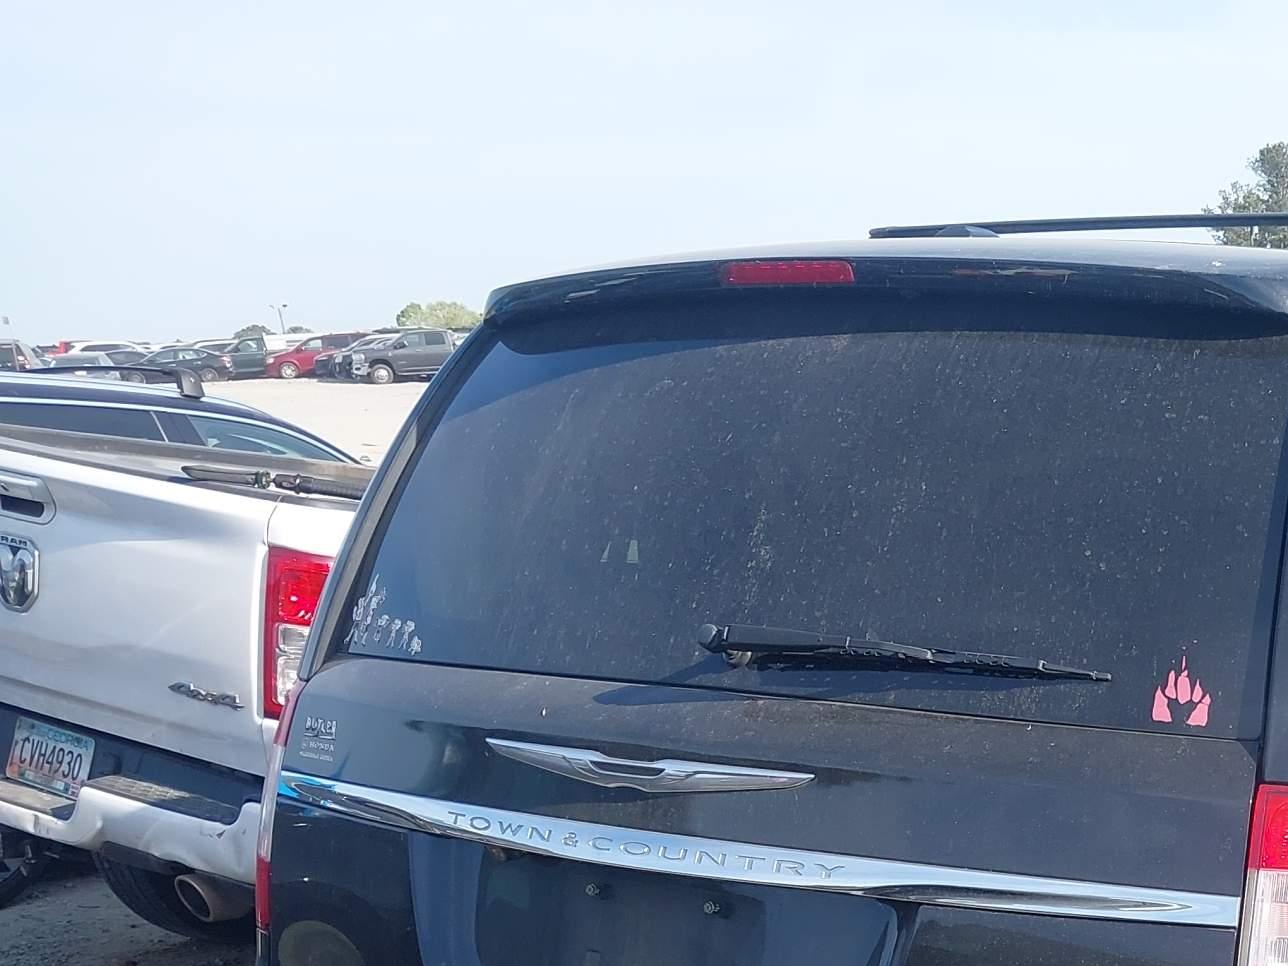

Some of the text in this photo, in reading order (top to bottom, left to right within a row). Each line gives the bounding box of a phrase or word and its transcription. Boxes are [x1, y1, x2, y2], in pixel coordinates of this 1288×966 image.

[0, 534, 28, 547] RAM
[309, 741, 335, 752] HONDA
[19, 736, 83, 781] CVH4930
